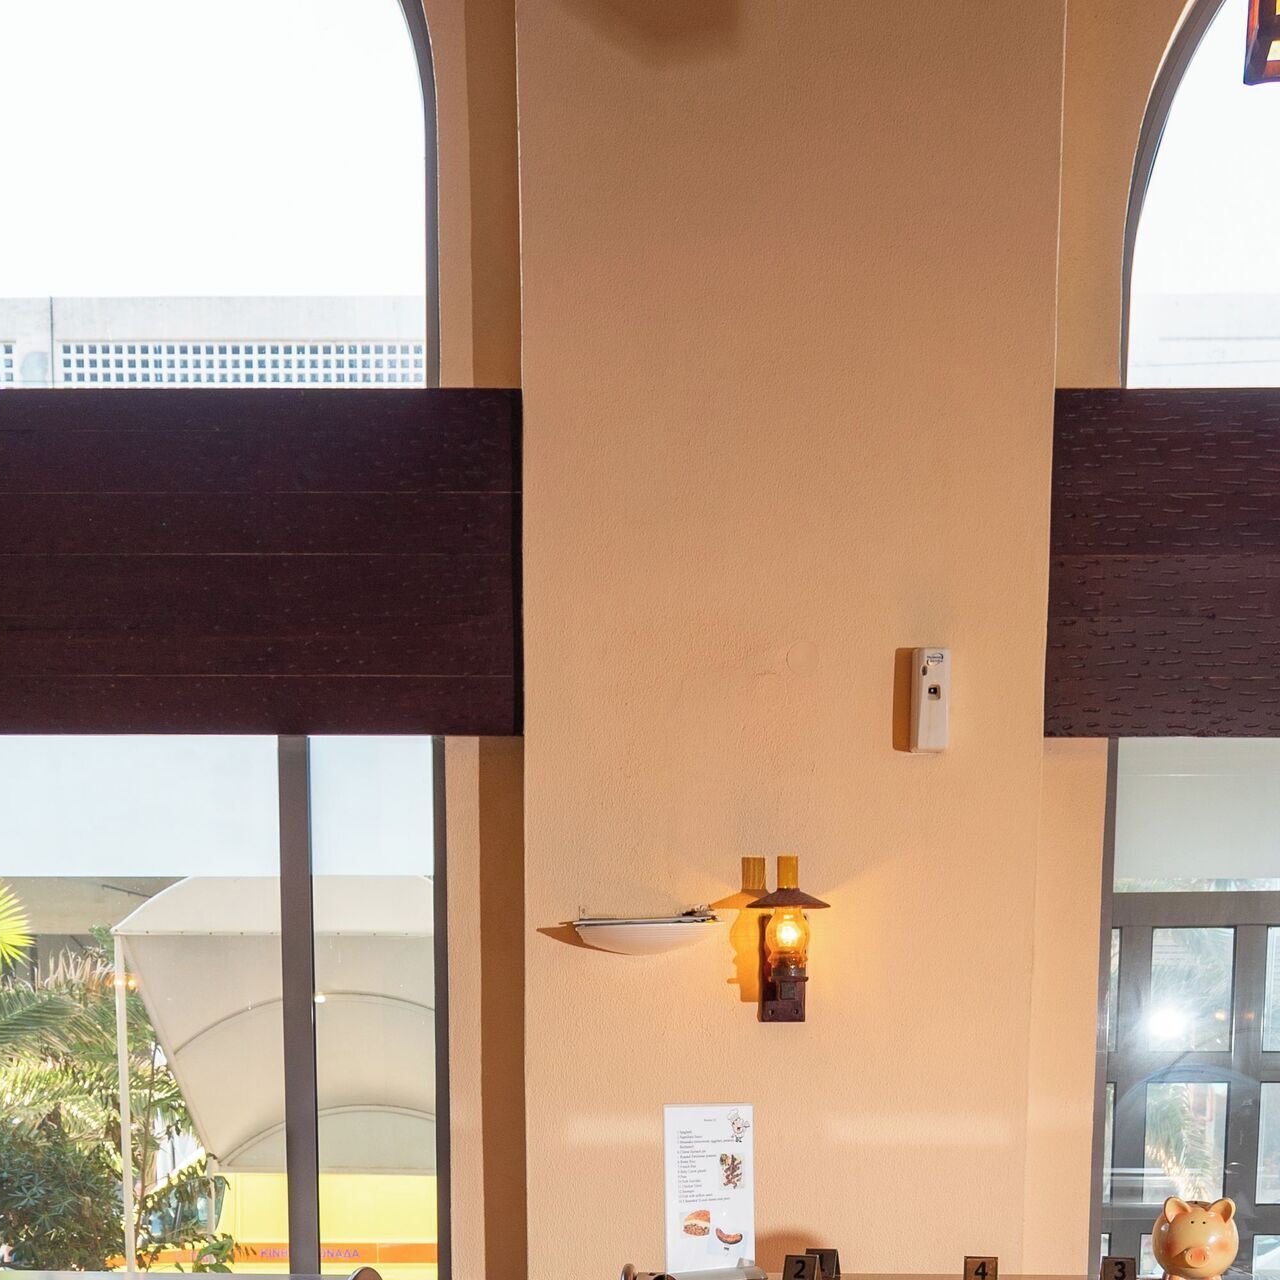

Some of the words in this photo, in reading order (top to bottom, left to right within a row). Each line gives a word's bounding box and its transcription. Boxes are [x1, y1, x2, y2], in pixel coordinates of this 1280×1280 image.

[793, 1259, 806, 1279] 2
[974, 1261, 988, 1280] 4
[1114, 1261, 1126, 1280] 3
